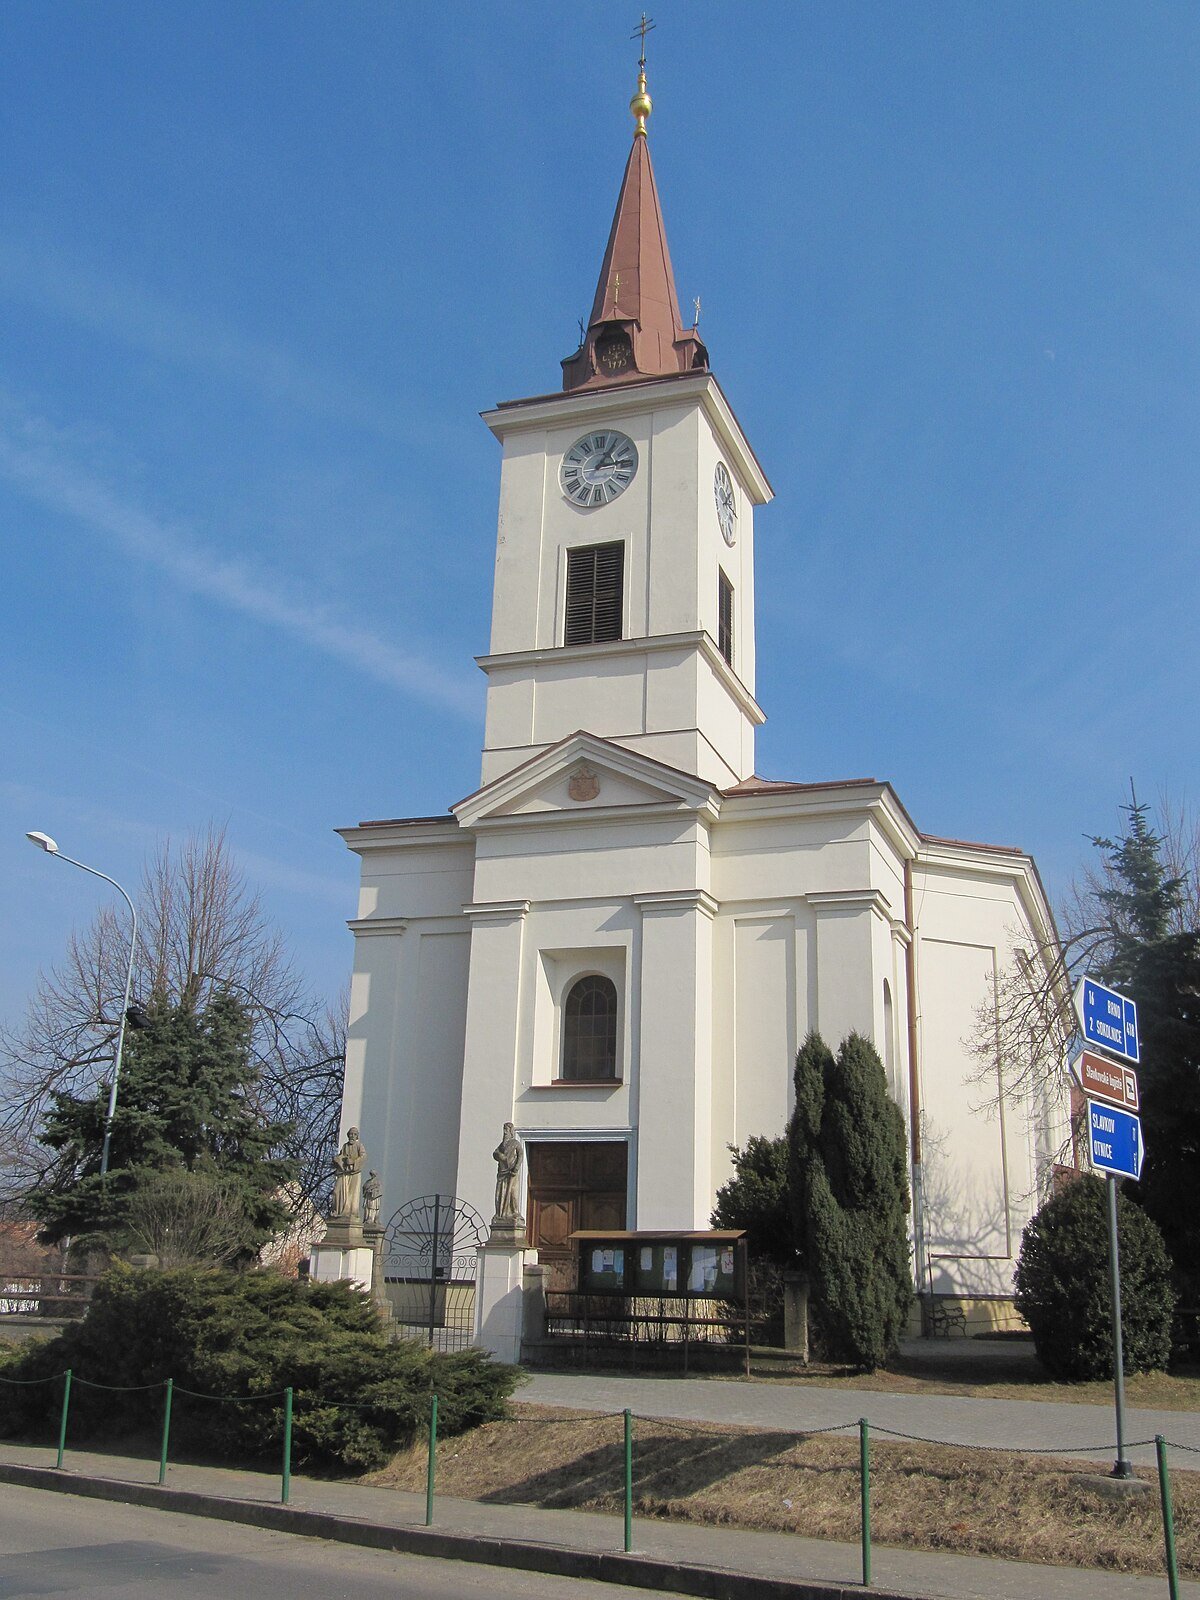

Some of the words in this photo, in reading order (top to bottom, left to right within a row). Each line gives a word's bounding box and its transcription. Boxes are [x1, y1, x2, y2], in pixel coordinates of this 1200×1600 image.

[1088, 990, 1095, 1005] 16
[1107, 999, 1121, 1019] BRNO
[1089, 1016, 1094, 1031] 2
[1096, 1020, 1122, 1044] SOKOLNICE
[1092, 1113, 1115, 1134] SLAVKOV
[1093, 1139, 1113, 1160] OTNICE
